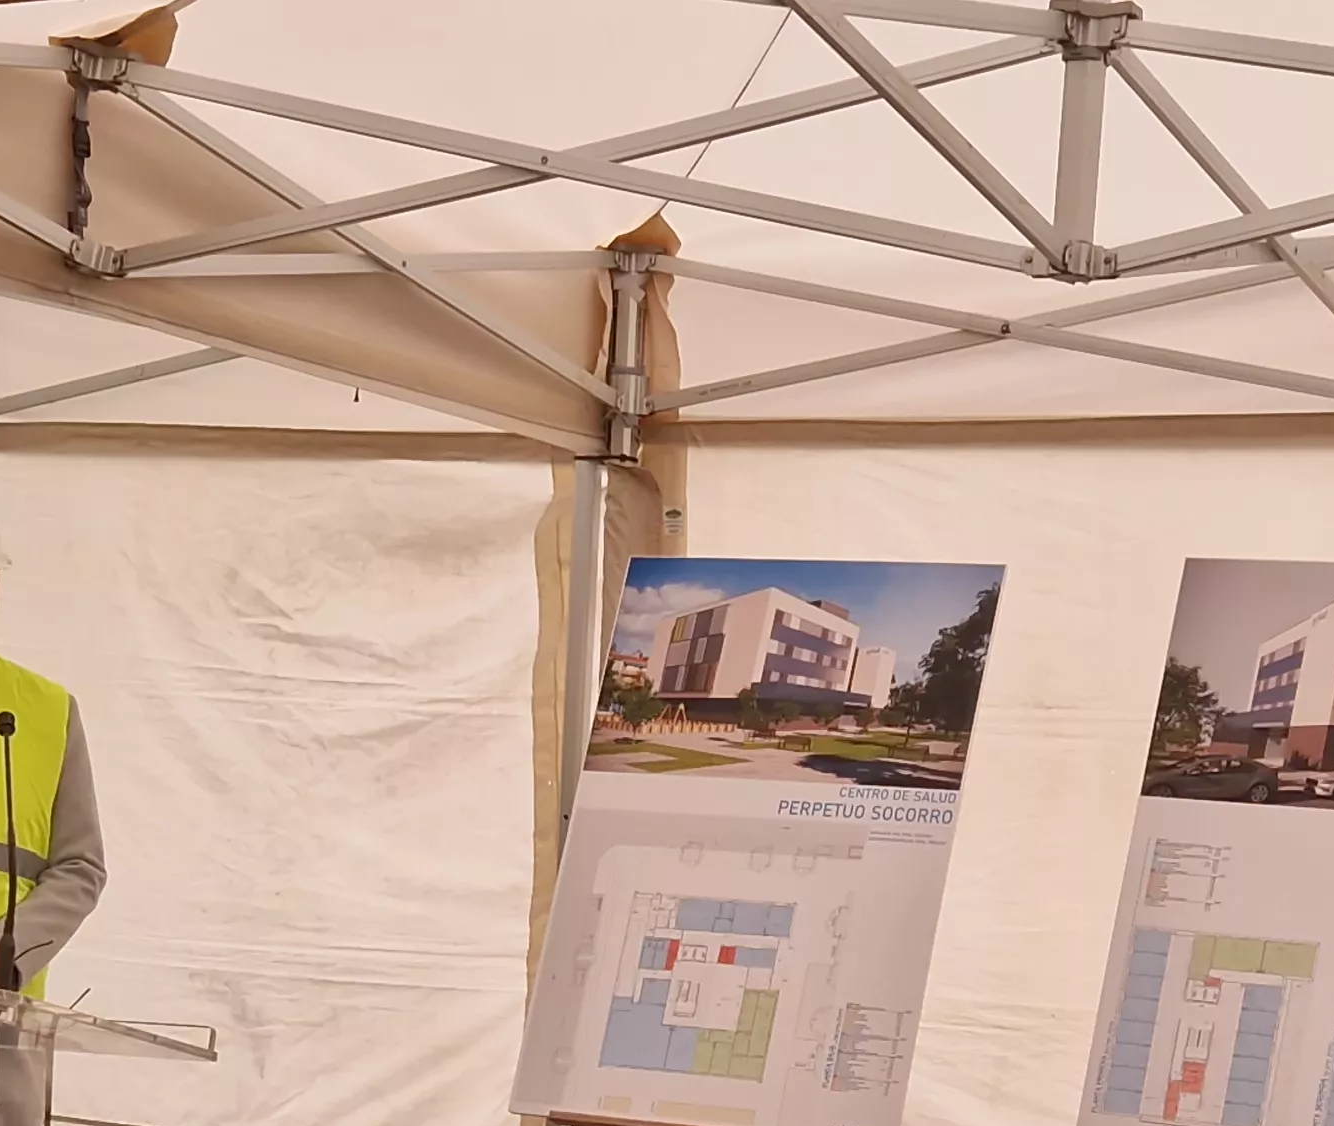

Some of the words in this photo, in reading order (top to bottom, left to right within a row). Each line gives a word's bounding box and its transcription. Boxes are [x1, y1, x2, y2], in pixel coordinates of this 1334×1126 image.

[839, 787, 889, 800] CENTRO
[893, 789, 910, 802] DE
[913, 791, 957, 804] SALUD
[777, 799, 866, 819] PERPETUO
[871, 806, 954, 825] SOCORRO
